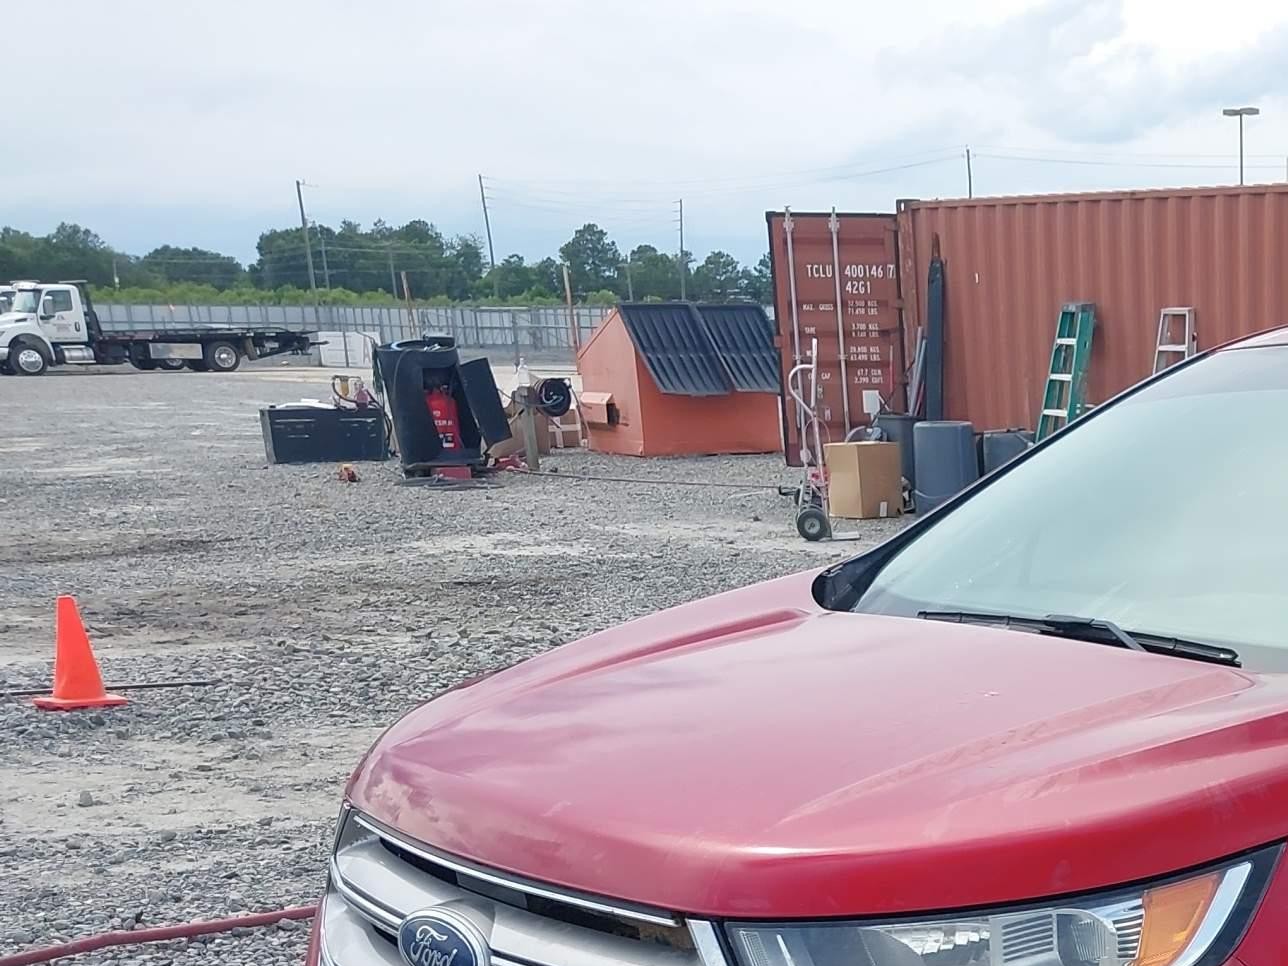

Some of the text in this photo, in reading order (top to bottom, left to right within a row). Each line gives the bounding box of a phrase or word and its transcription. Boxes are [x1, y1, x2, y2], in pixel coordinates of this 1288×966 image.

[806, 264, 833, 277] TCLU
[844, 264, 883, 278] 400146
[845, 281, 871, 294] 42G1
